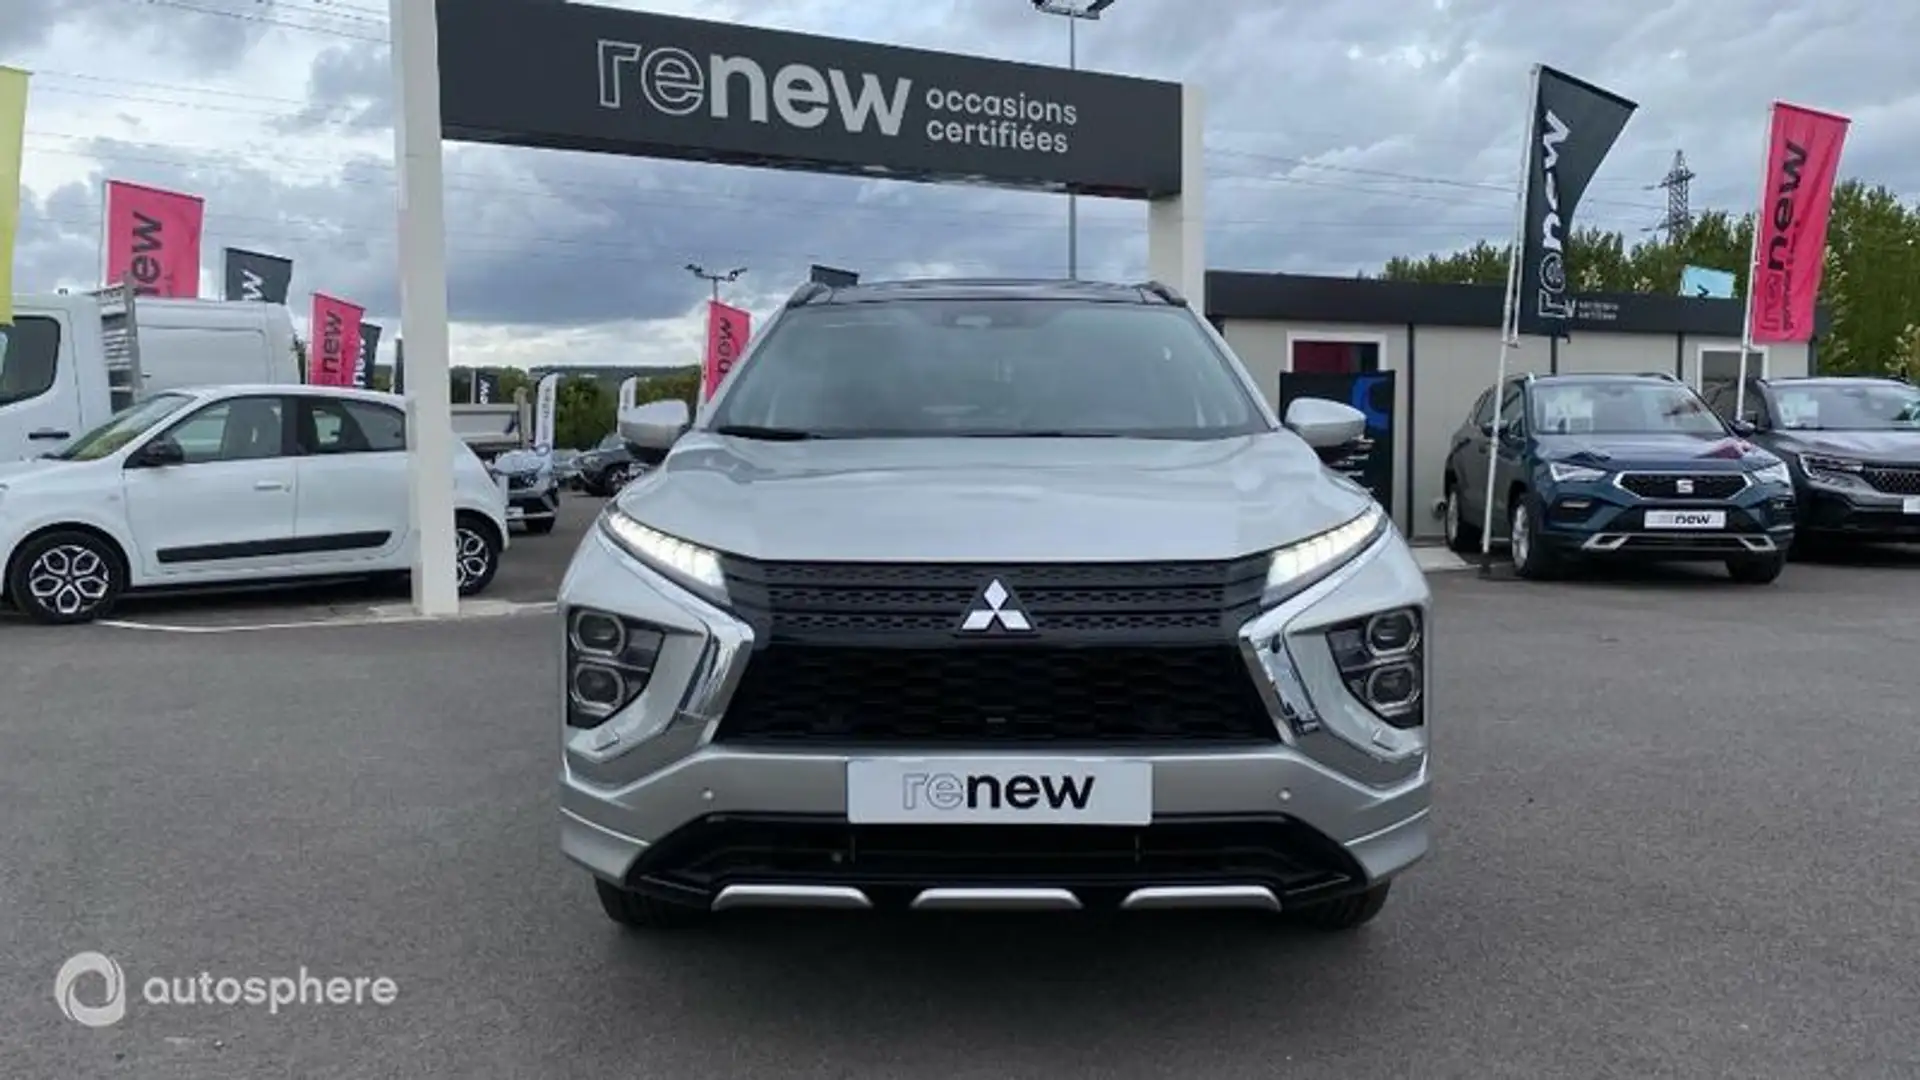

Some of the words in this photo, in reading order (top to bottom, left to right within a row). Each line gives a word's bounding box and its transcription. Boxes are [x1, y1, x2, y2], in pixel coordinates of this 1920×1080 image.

[597, 39, 912, 136] renew
[926, 88, 1077, 124] occasions
[926, 118, 1068, 154] certifiées
[902, 773, 1095, 810] renew
